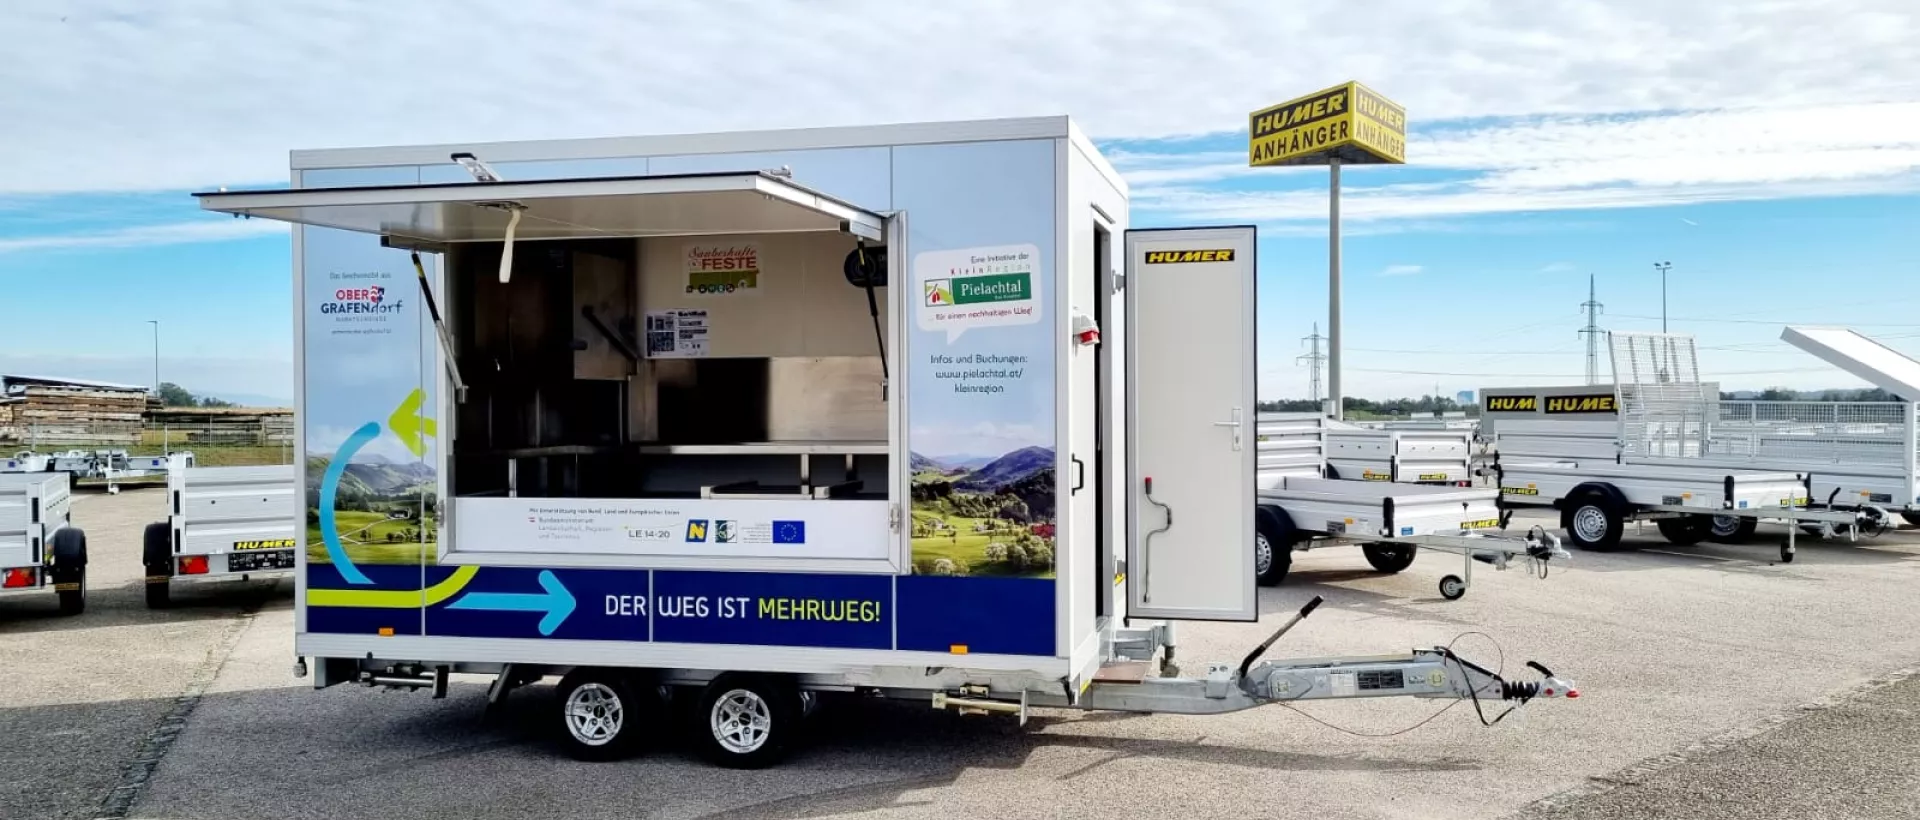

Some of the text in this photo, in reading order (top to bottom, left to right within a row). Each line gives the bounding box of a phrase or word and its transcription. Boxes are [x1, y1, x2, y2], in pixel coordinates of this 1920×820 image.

[1256, 96, 1346, 134] HUMER
[1358, 93, 1403, 131] HUMER
[1252, 119, 1348, 163] ANHÄNGER
[1356, 119, 1405, 160] ANHÄNGER
[1148, 250, 1231, 262] HUMER
[701, 257, 757, 270] FESTE
[960, 279, 1023, 297] Pielachtal
[336, 289, 369, 301] OBER
[320, 299, 403, 314] GRAFENdorf
[930, 354, 1028, 367] Infos und Buchungen:
[936, 368, 1024, 381] www.pielachtal.at/
[954, 383, 1004, 395] kleinregion
[628, 529, 643, 538] LE
[236, 540, 295, 550] HUMER
[605, 595, 881, 622] DER WEG IST MEHRWEG!
